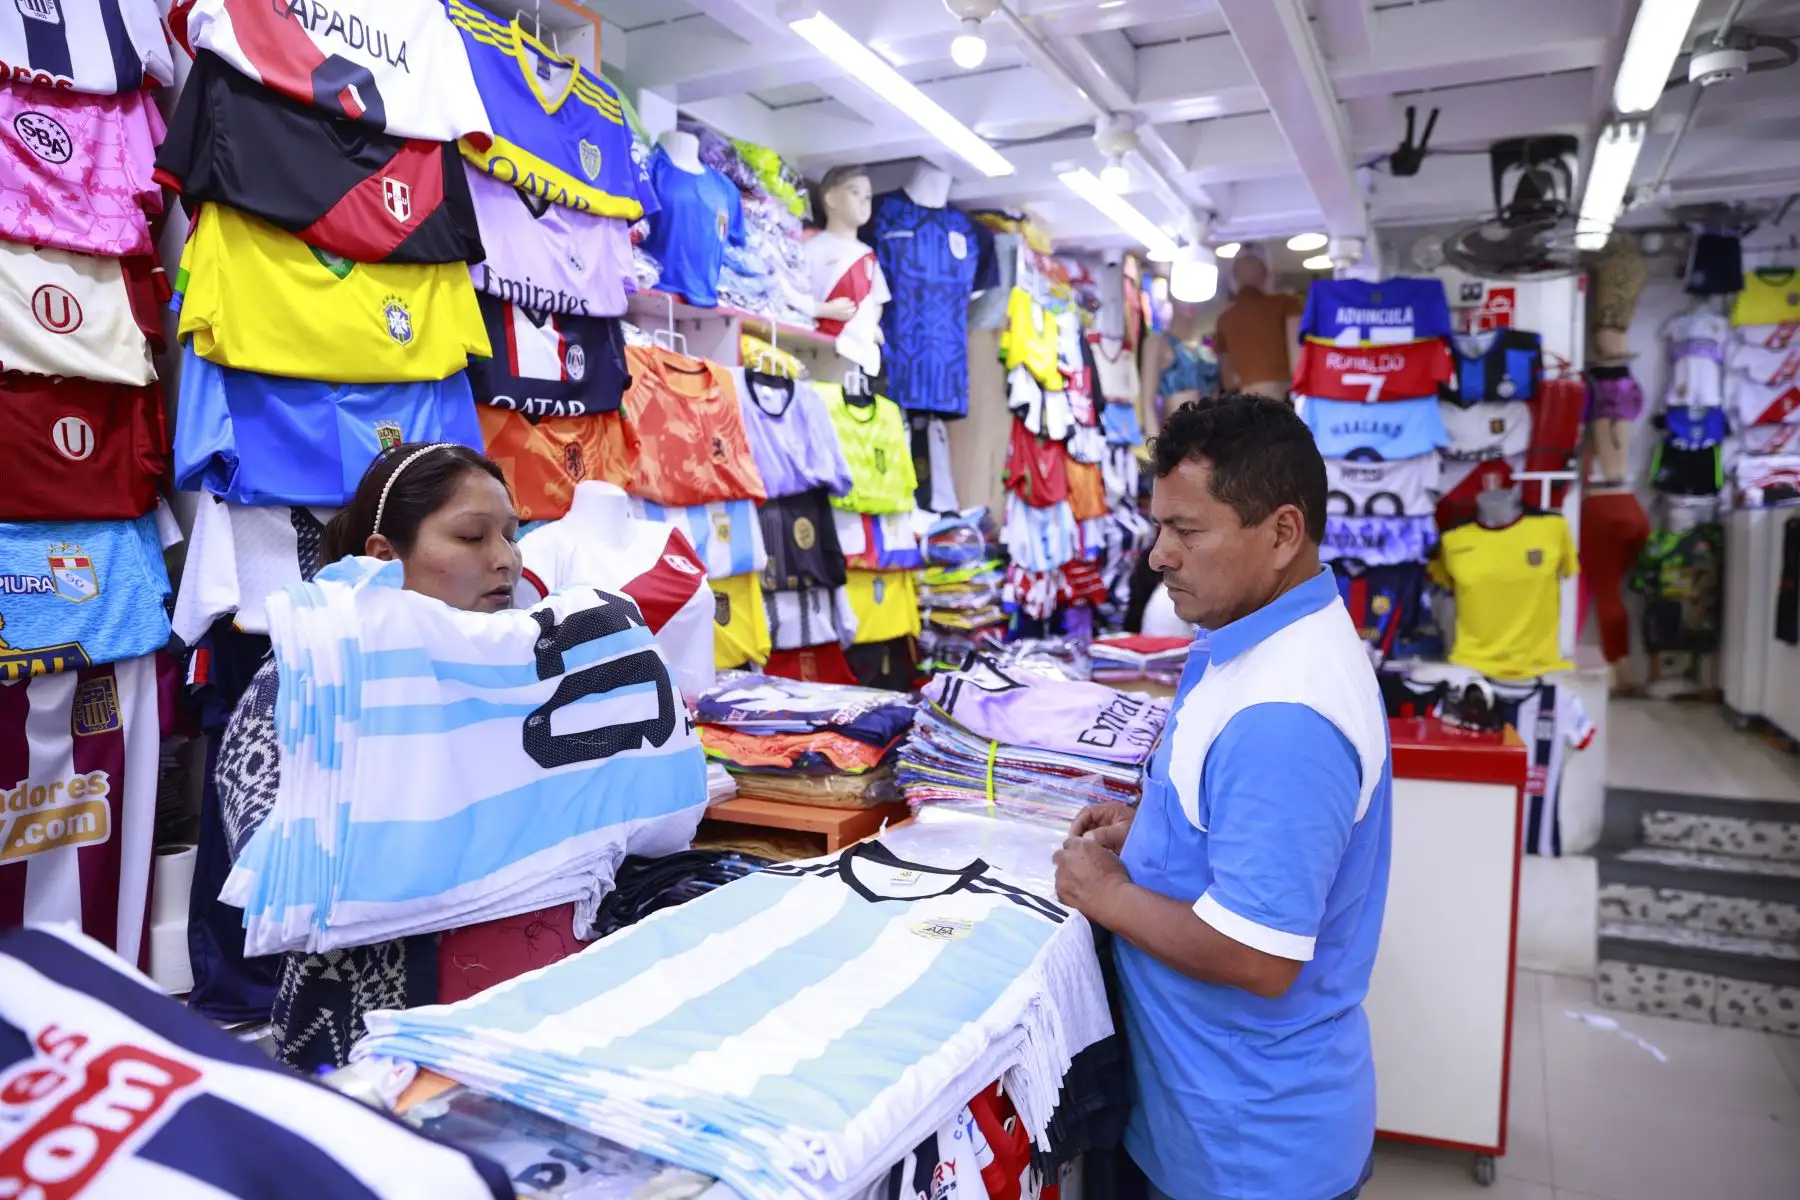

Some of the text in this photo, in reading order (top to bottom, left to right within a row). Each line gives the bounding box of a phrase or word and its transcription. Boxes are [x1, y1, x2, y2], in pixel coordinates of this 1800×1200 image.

[272, 0, 410, 74] LAPADULA
[20, 117, 67, 157] SBA
[45, 291, 70, 328] U
[483, 264, 590, 317] Emirates
[1341, 373, 1386, 403] 7
[62, 422, 86, 458] U
[0, 774, 106, 814] dores
